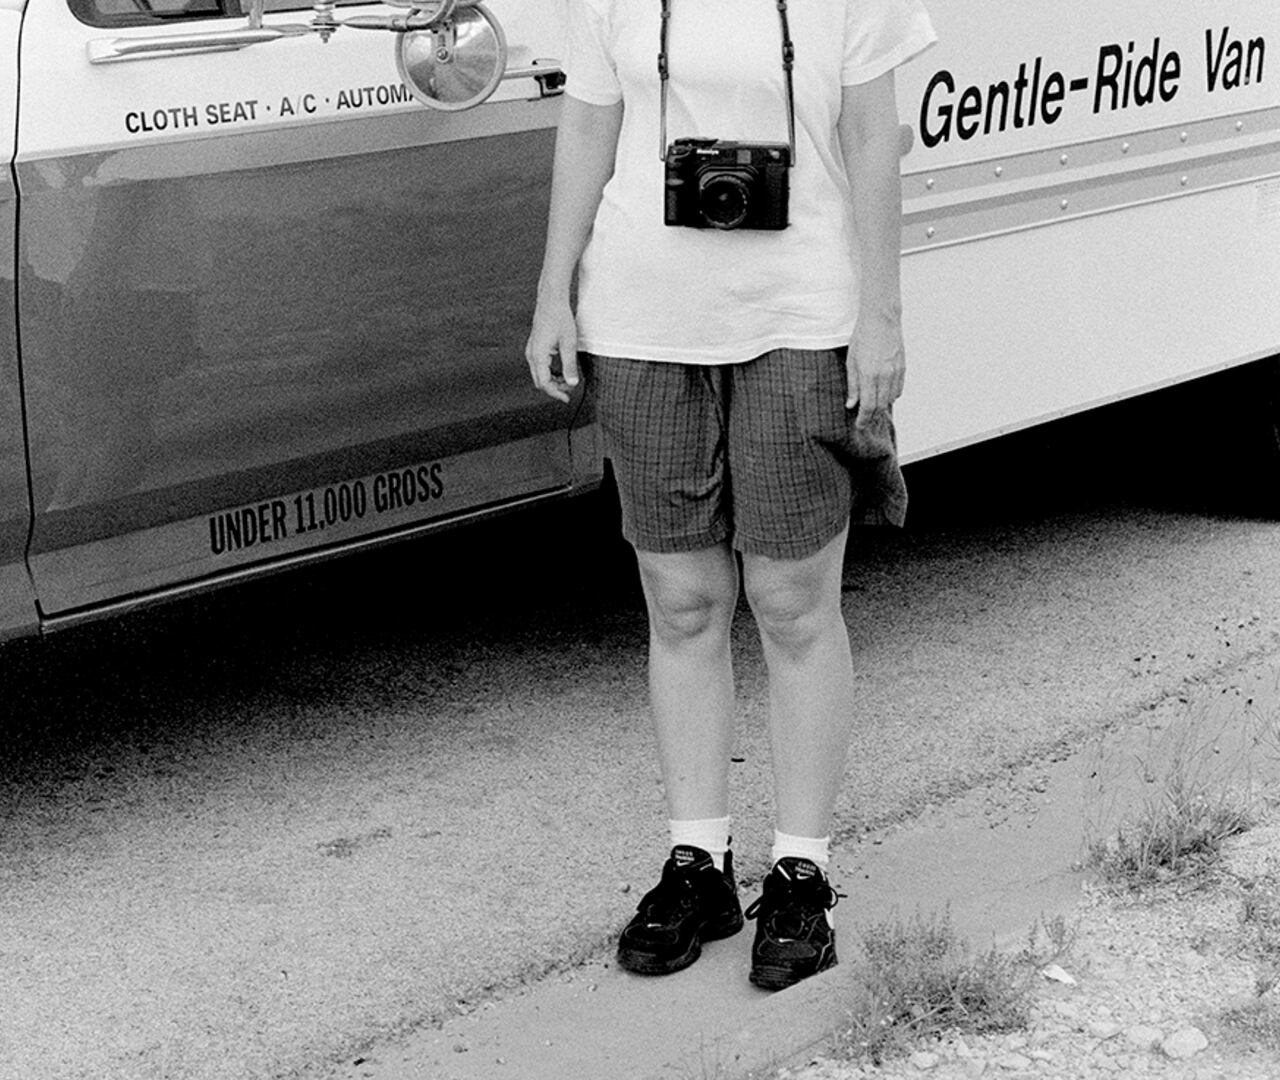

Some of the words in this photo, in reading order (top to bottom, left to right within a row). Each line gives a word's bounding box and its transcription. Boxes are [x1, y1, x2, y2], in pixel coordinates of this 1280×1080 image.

[125, 106, 199, 134] CLOTH
[205, 100, 259, 126] SEAT
[279, 93, 318, 117] A/C
[919, 37, 1182, 149] Gentle-Ride
[1206, 26, 1266, 92] Van
[209, 500, 288, 556] UNDER
[293, 480, 367, 535] 11,000
[373, 463, 444, 514] GROSS
